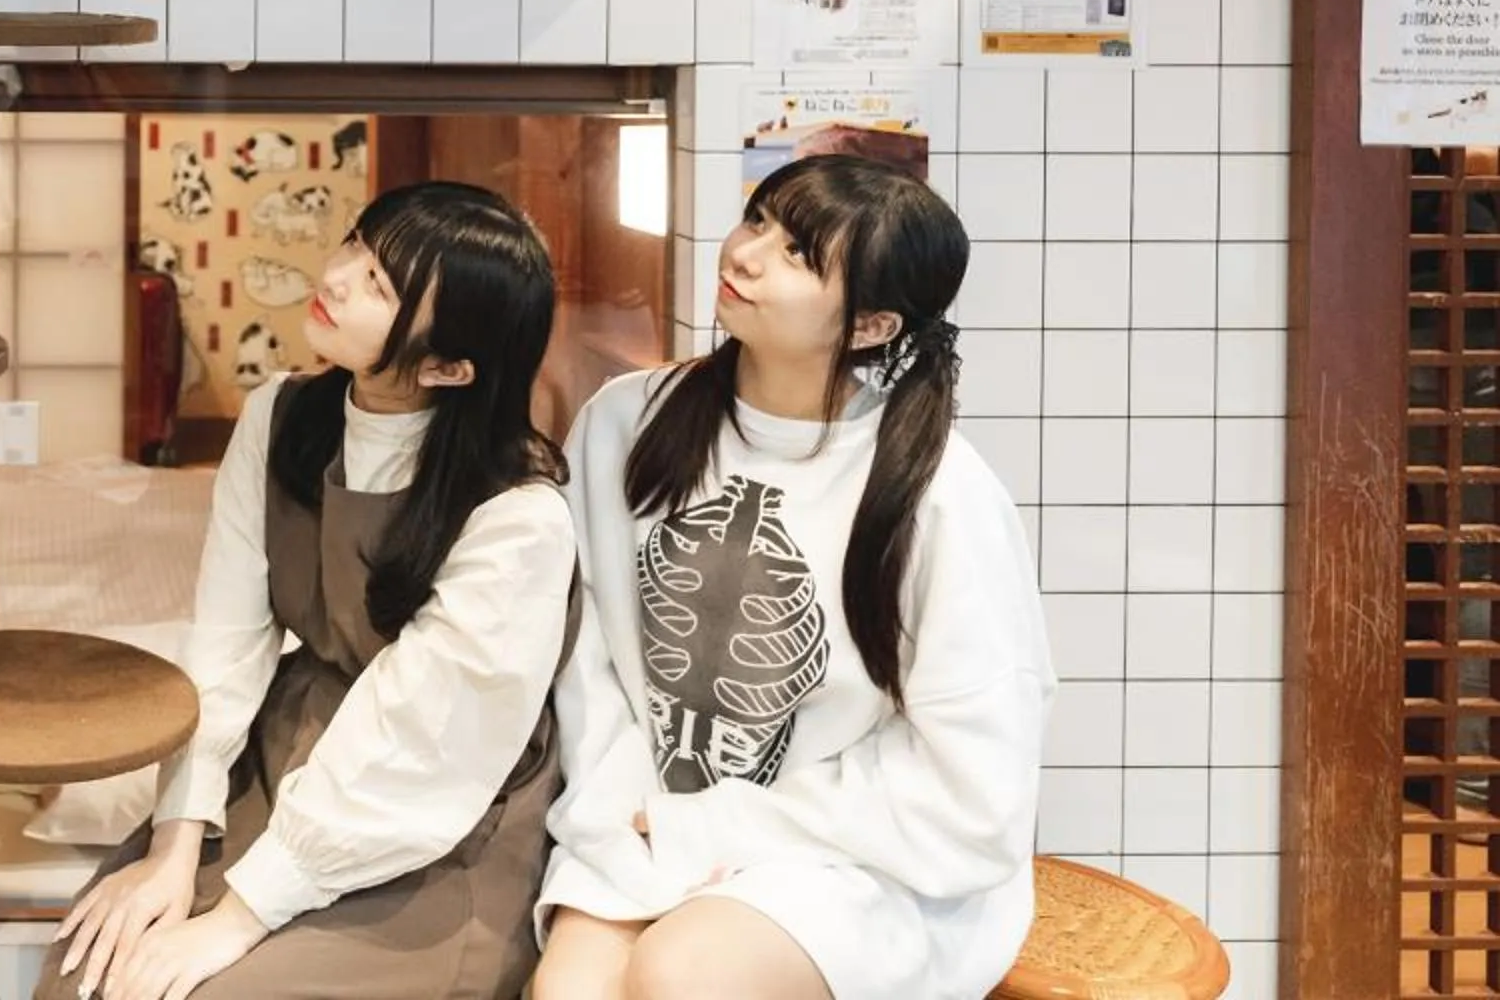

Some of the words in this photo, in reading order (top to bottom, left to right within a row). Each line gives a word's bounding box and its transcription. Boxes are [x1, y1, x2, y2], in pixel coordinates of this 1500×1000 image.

[1414, 33, 1445, 45] Close
[1446, 33, 1463, 45] the
[1465, 33, 1491, 45] door
